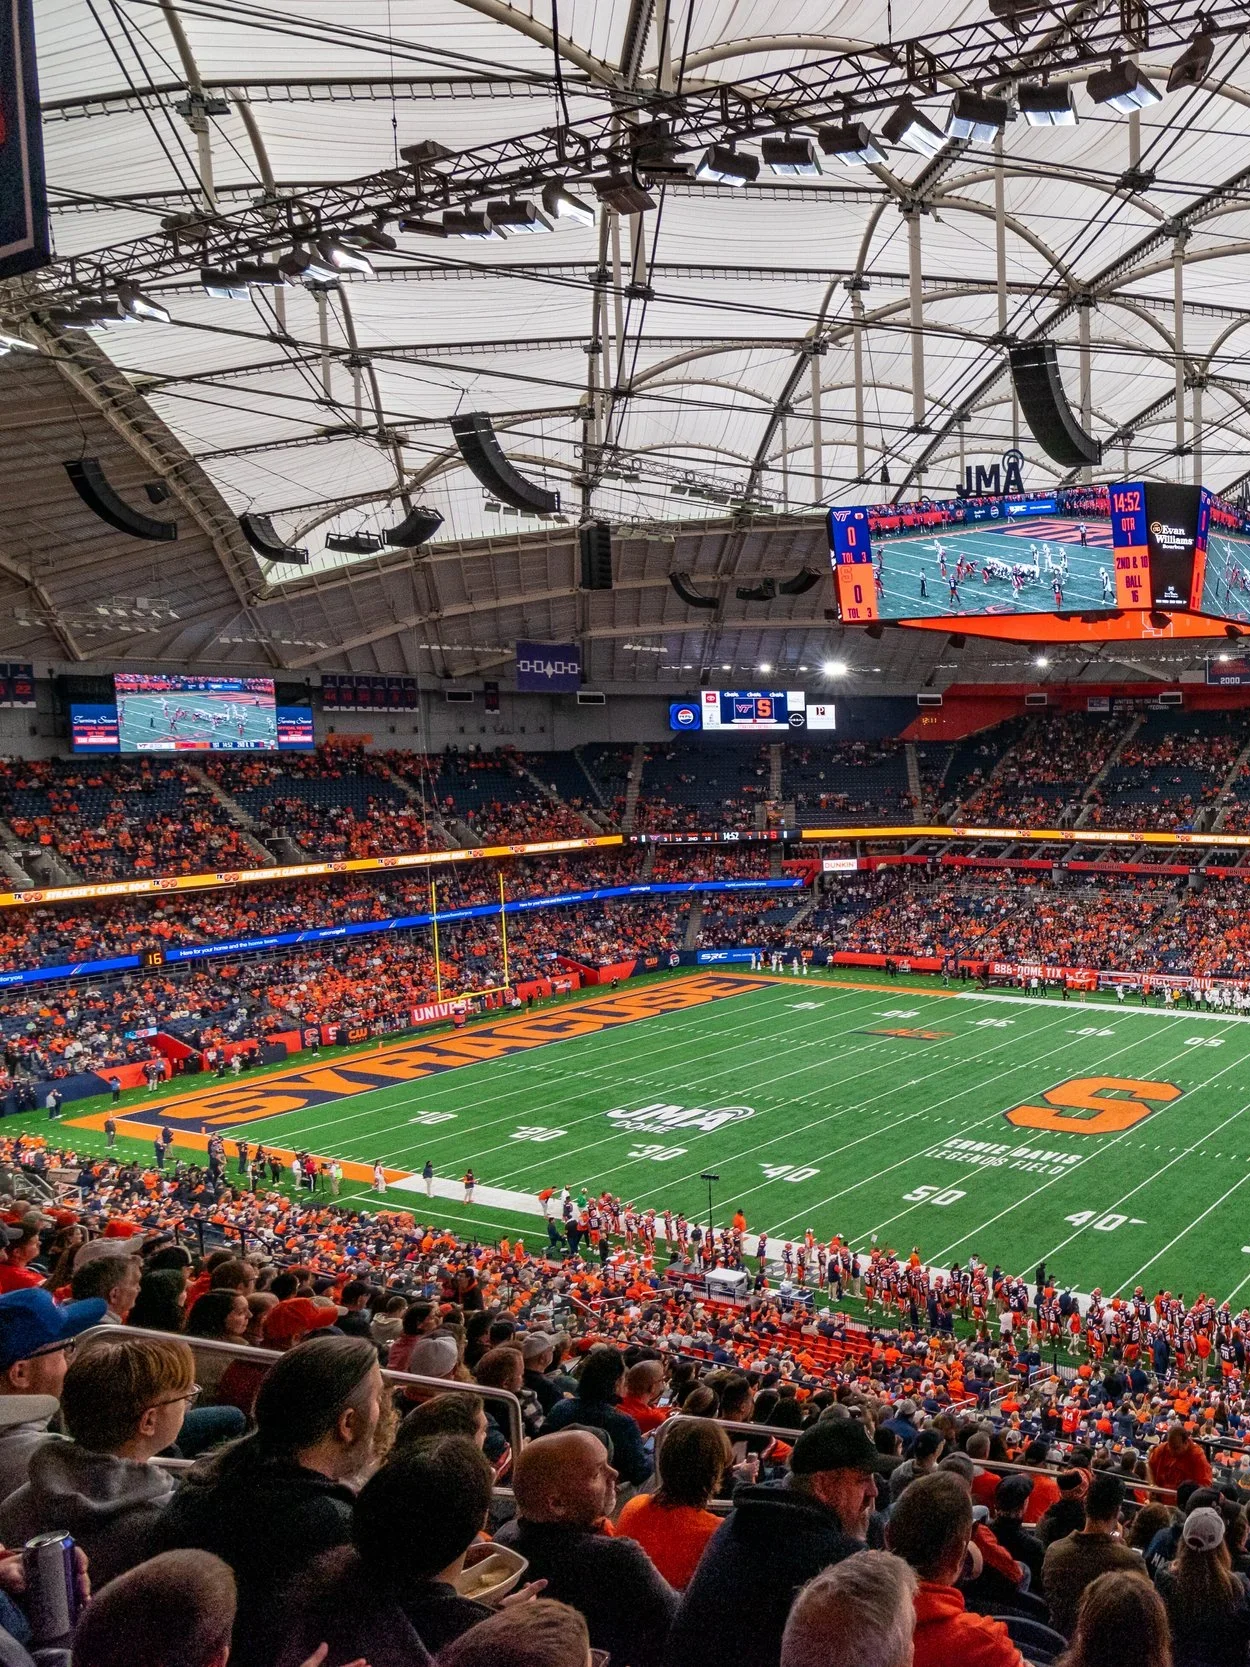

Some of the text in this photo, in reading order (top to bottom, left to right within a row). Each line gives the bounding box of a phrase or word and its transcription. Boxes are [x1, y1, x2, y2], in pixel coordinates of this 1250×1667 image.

[956, 460, 1025, 498] JMA
[1113, 492, 1141, 512] 14:52
[1121, 518, 1136, 531] QTR
[1162, 525, 1186, 536] Evan
[847, 527, 856, 547] 0
[1155, 534, 1194, 545] Williams
[842, 552, 855, 563] TOL
[1116, 556, 1130, 569] 2ND
[1125, 575, 1142, 588] BALL
[854, 585, 862, 604] 0
[1131, 590, 1139, 603] 16
[848, 608, 861, 619] TOL
[1220, 676, 1240, 685] 2000
[756, 699, 772, 717] S
[722, 832, 739, 840] 14:52
[824, 860, 856, 869] DUNKIN'
[149, 952, 161, 965] 16
[180, 949, 193, 957] Here
[201, 947, 213, 955] your
[701, 952, 728, 962] SRC
[994, 963, 1062, 978] 888-DOME TIX
[1184, 1037, 1226, 1048] 50
[157, 976, 763, 1125] SYRACUSE
[1001, 1075, 1186, 1135] S
[413, 1111, 459, 1125] 10
[606, 1103, 745, 1132] JMA
[509, 1126, 568, 1142] 20
[610, 1120, 676, 1134] DOME
[626, 1144, 689, 1161] 30
[942, 1138, 1083, 1165] ERNIE DAVIS
[924, 1148, 1065, 1175] LEGENDS FIELD
[762, 1164, 820, 1182] 40
[902, 1184, 967, 1206] 50
[1064, 1209, 1129, 1231] 40
